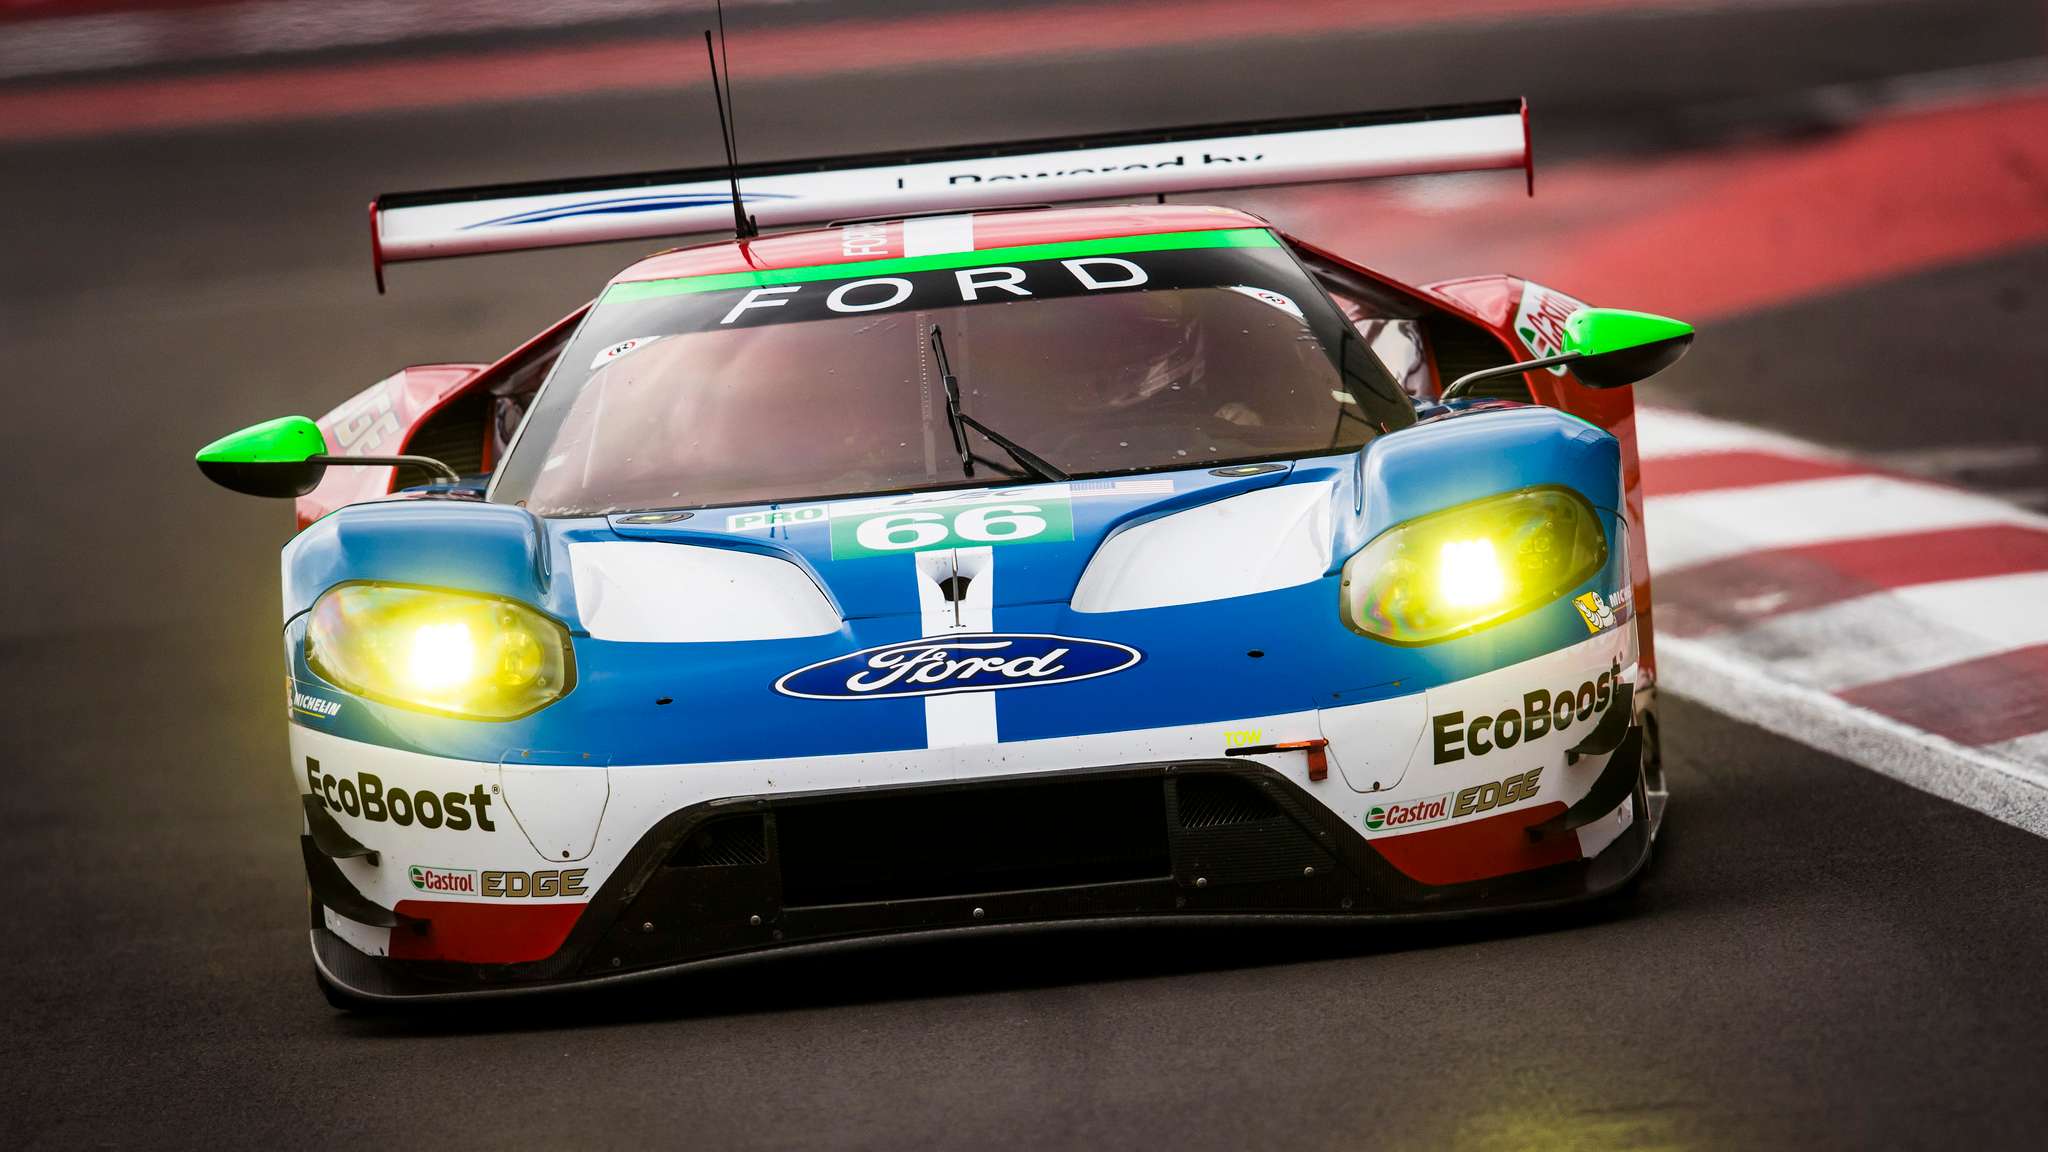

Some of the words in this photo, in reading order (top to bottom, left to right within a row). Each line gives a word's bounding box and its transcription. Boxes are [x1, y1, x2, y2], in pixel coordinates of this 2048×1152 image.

[720, 256, 1148, 325] FORD
[735, 508, 824, 528] PRO
[856, 503, 1047, 551] 66
[846, 641, 1070, 692] Ford
[294, 692, 341, 716] MICHELIN
[1432, 655, 1621, 765] EcoBoost
[1224, 727, 1263, 747] TOW
[1386, 797, 1445, 826] Castrol
[1452, 766, 1544, 818] EDGE
[424, 870, 474, 893] Castrol
[481, 867, 589, 898] EDGE
